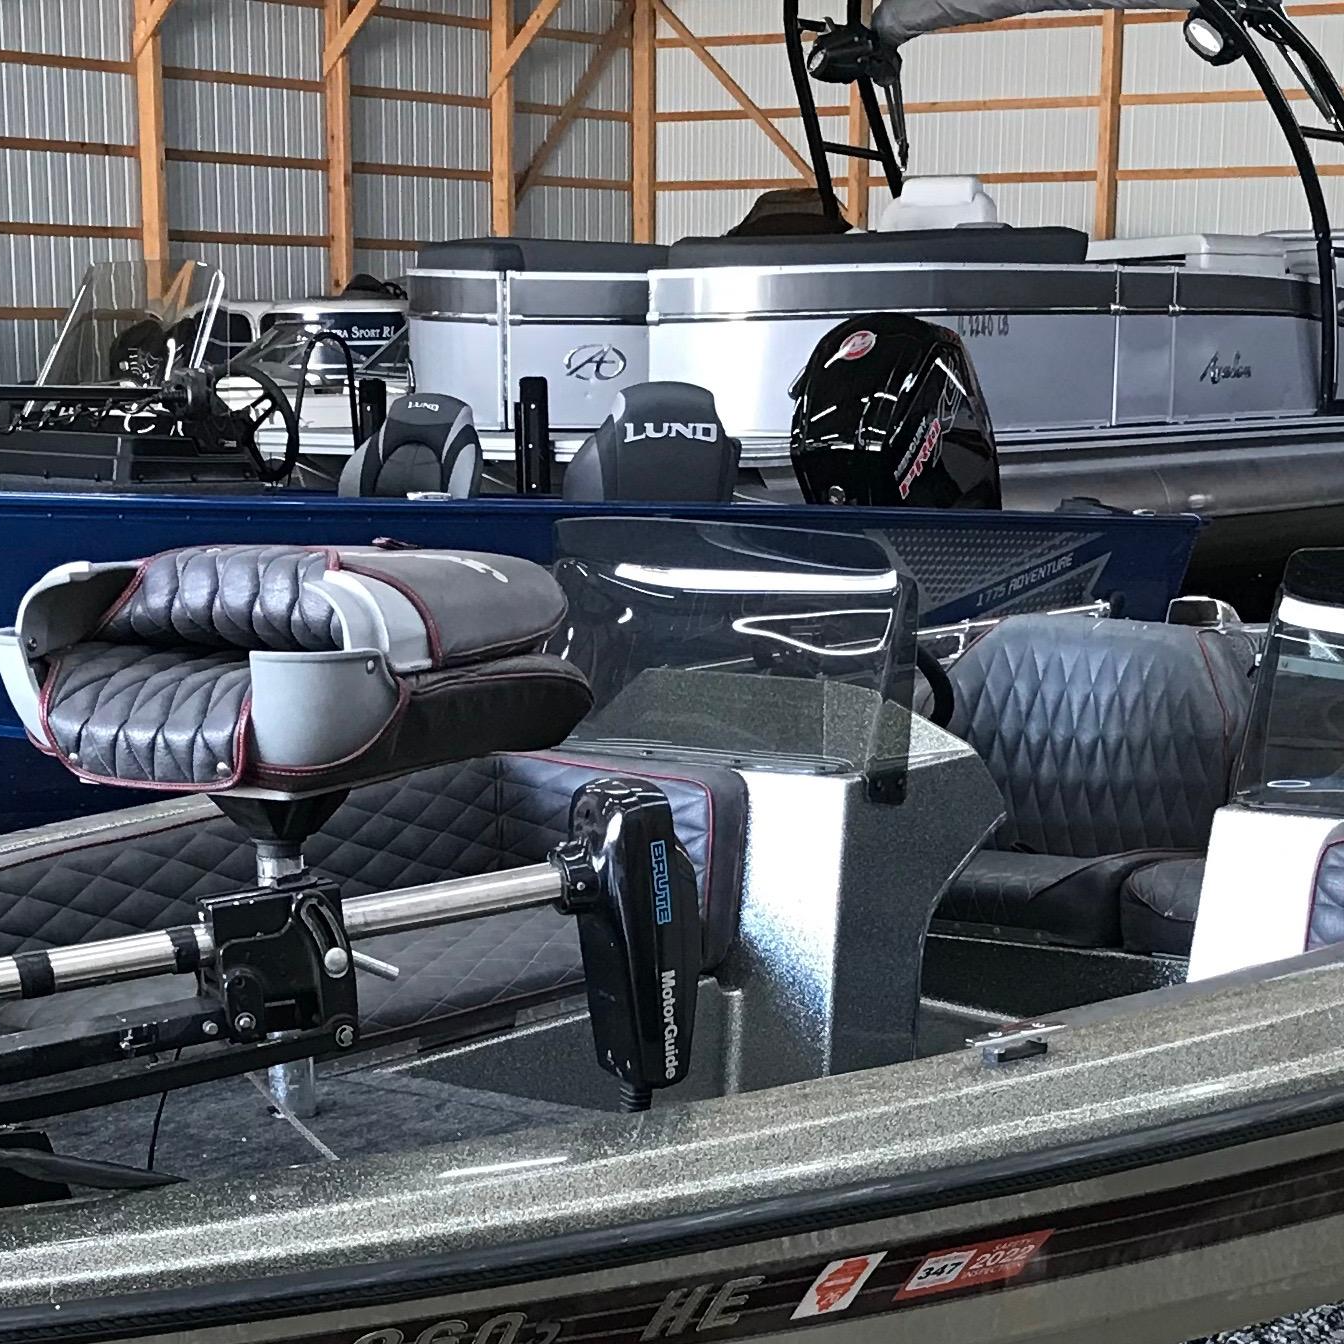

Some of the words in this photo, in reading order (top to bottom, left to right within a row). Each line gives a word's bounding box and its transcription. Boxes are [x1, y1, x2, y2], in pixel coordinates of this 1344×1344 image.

[408, 401, 439, 412] LUND
[624, 422, 717, 443] LUND
[1008, 552, 1074, 595] ADVENTURE
[650, 840, 672, 925] BRUTE
[661, 970, 679, 1080] MotorGuide
[917, 1262, 962, 1281] 347
[969, 1245, 1035, 1270] 2022
[640, 1275, 765, 1342] HE
